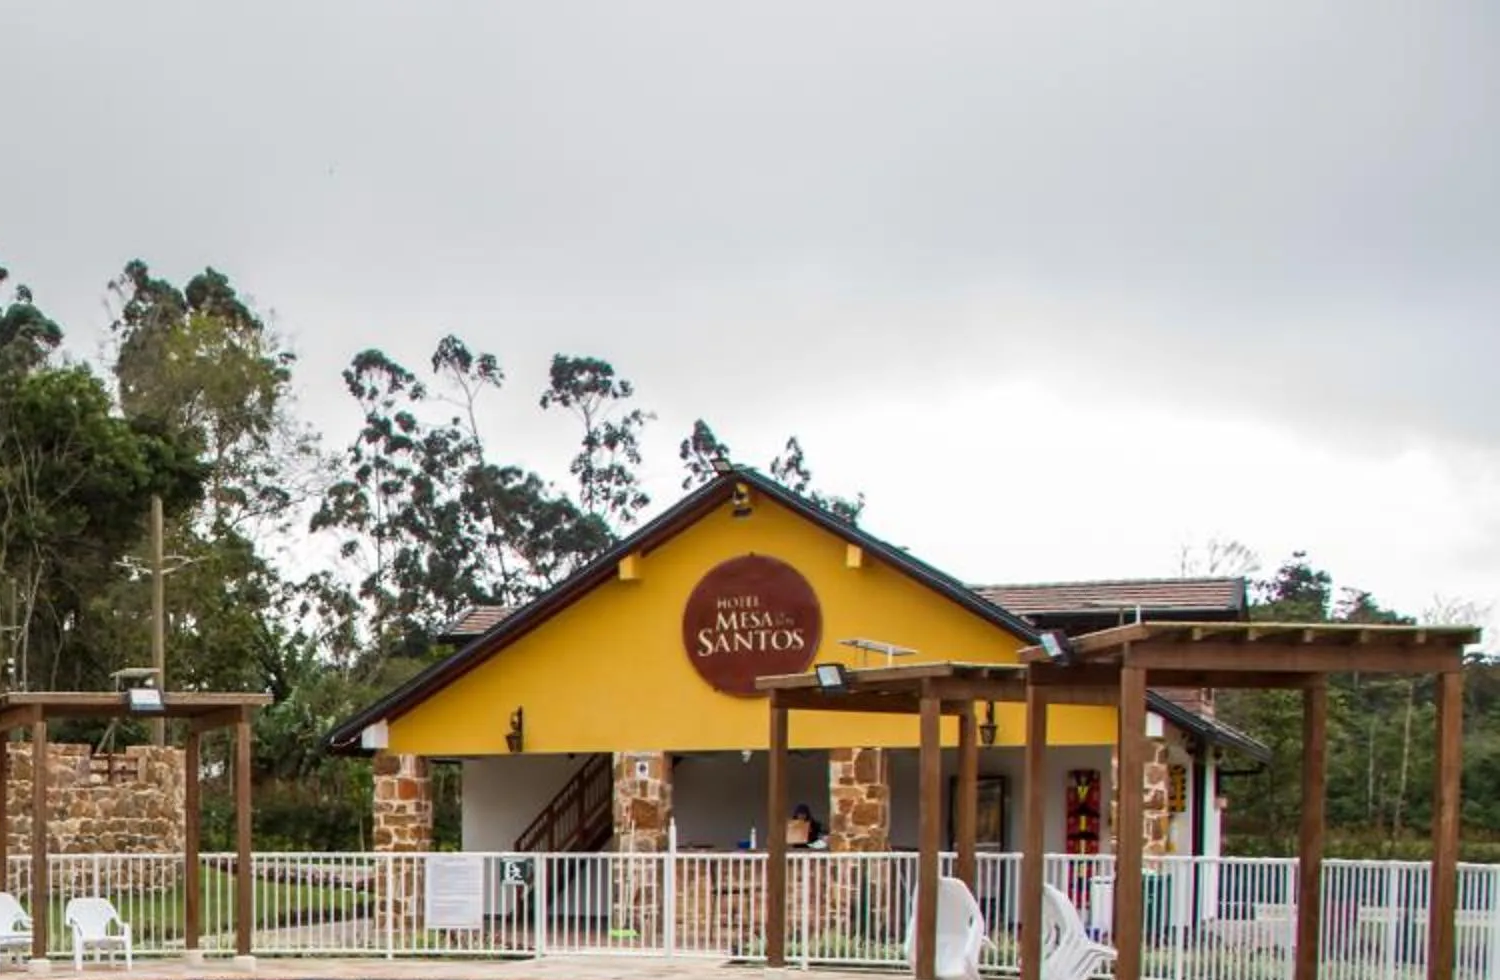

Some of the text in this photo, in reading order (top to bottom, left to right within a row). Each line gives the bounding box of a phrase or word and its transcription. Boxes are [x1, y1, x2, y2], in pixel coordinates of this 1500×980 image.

[717, 596, 759, 609] HOTEL
[716, 611, 773, 630] MESA
[698, 628, 804, 656] SANTOS
